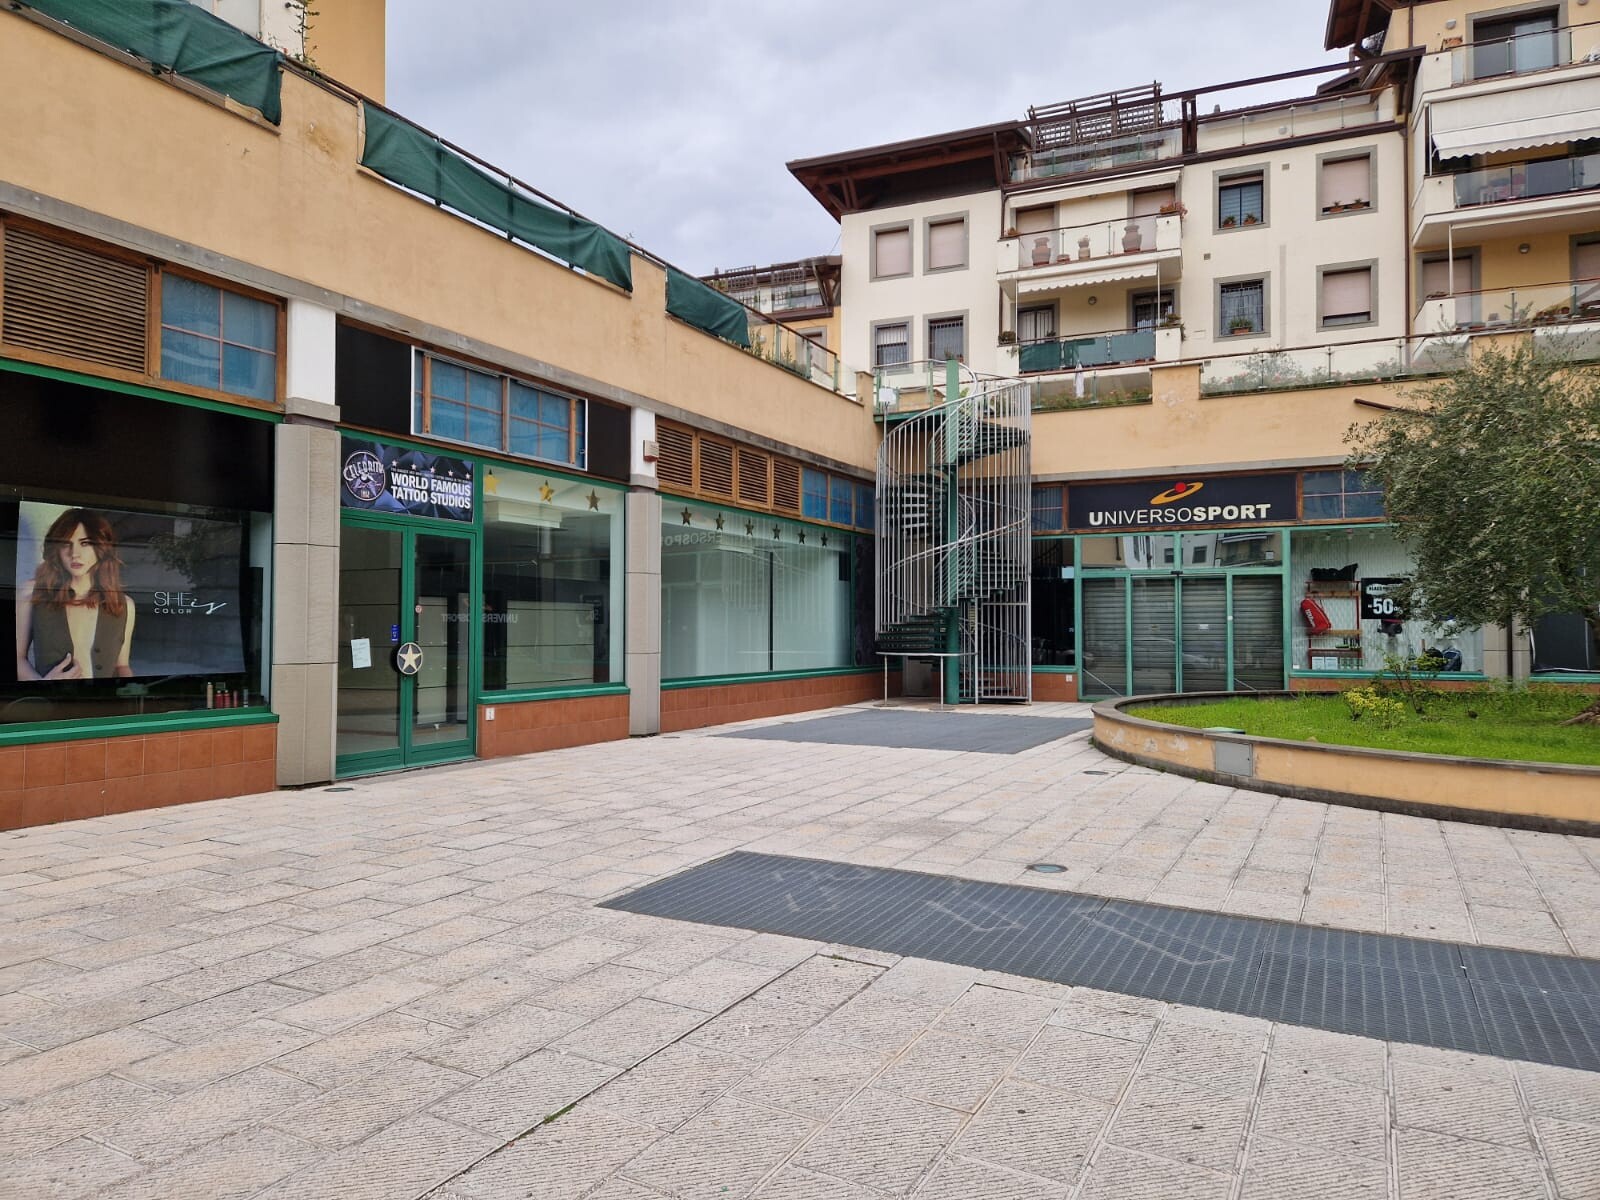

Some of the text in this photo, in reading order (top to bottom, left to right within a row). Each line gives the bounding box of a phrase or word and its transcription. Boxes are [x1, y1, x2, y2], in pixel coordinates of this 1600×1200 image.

[390, 471, 428, 490] WORLD
[430, 479, 471, 497] FAMOUS
[390, 486, 428, 503] TATTOO
[430, 492, 471, 509] STUDIOS
[1089, 503, 1271, 526] UNIVERSOSPORT
